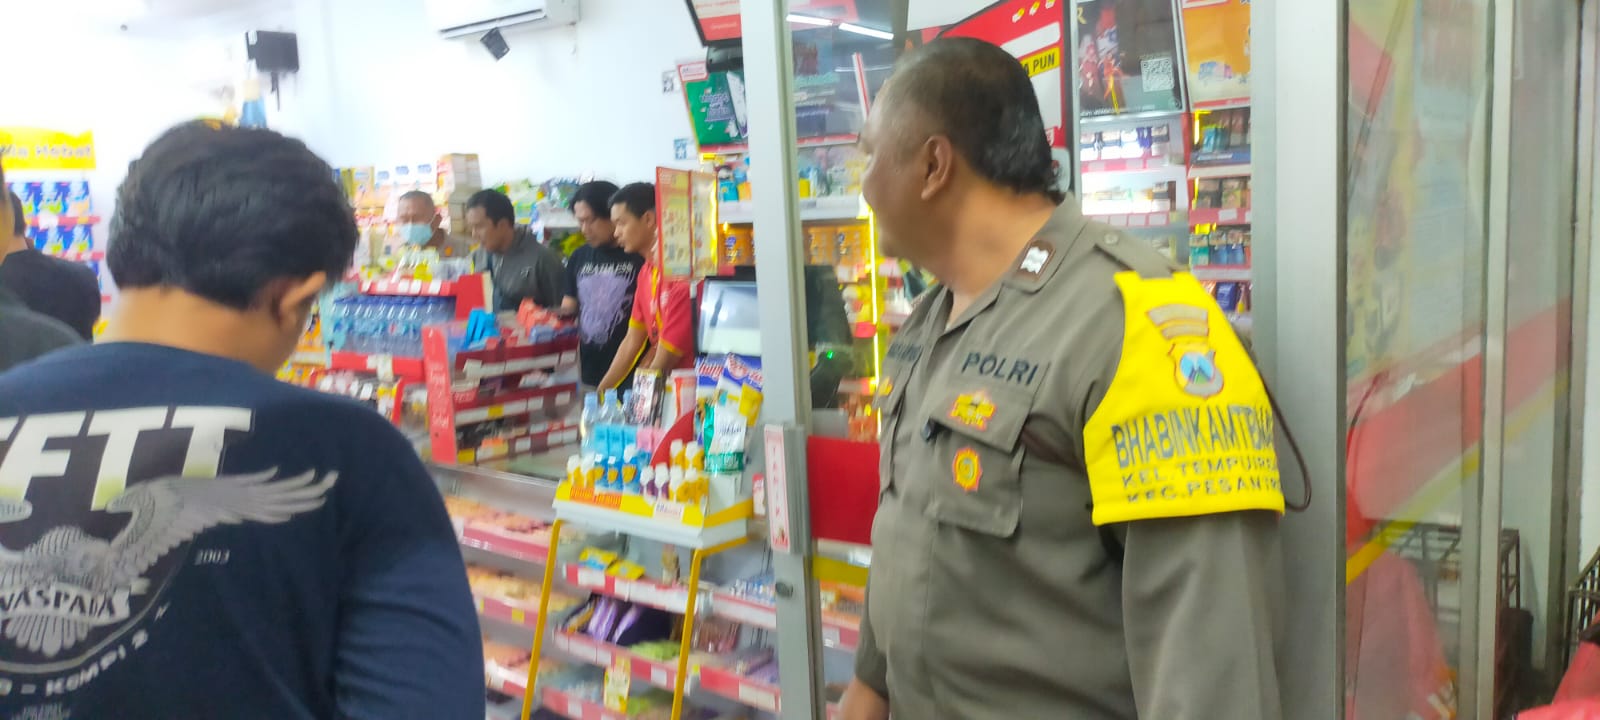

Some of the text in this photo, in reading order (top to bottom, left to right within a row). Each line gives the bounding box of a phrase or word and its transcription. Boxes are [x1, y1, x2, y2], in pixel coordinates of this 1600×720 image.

[1033, 52, 1055, 73] PUN
[961, 351, 1039, 386] POLRI
[194, 549, 231, 566] 2003
